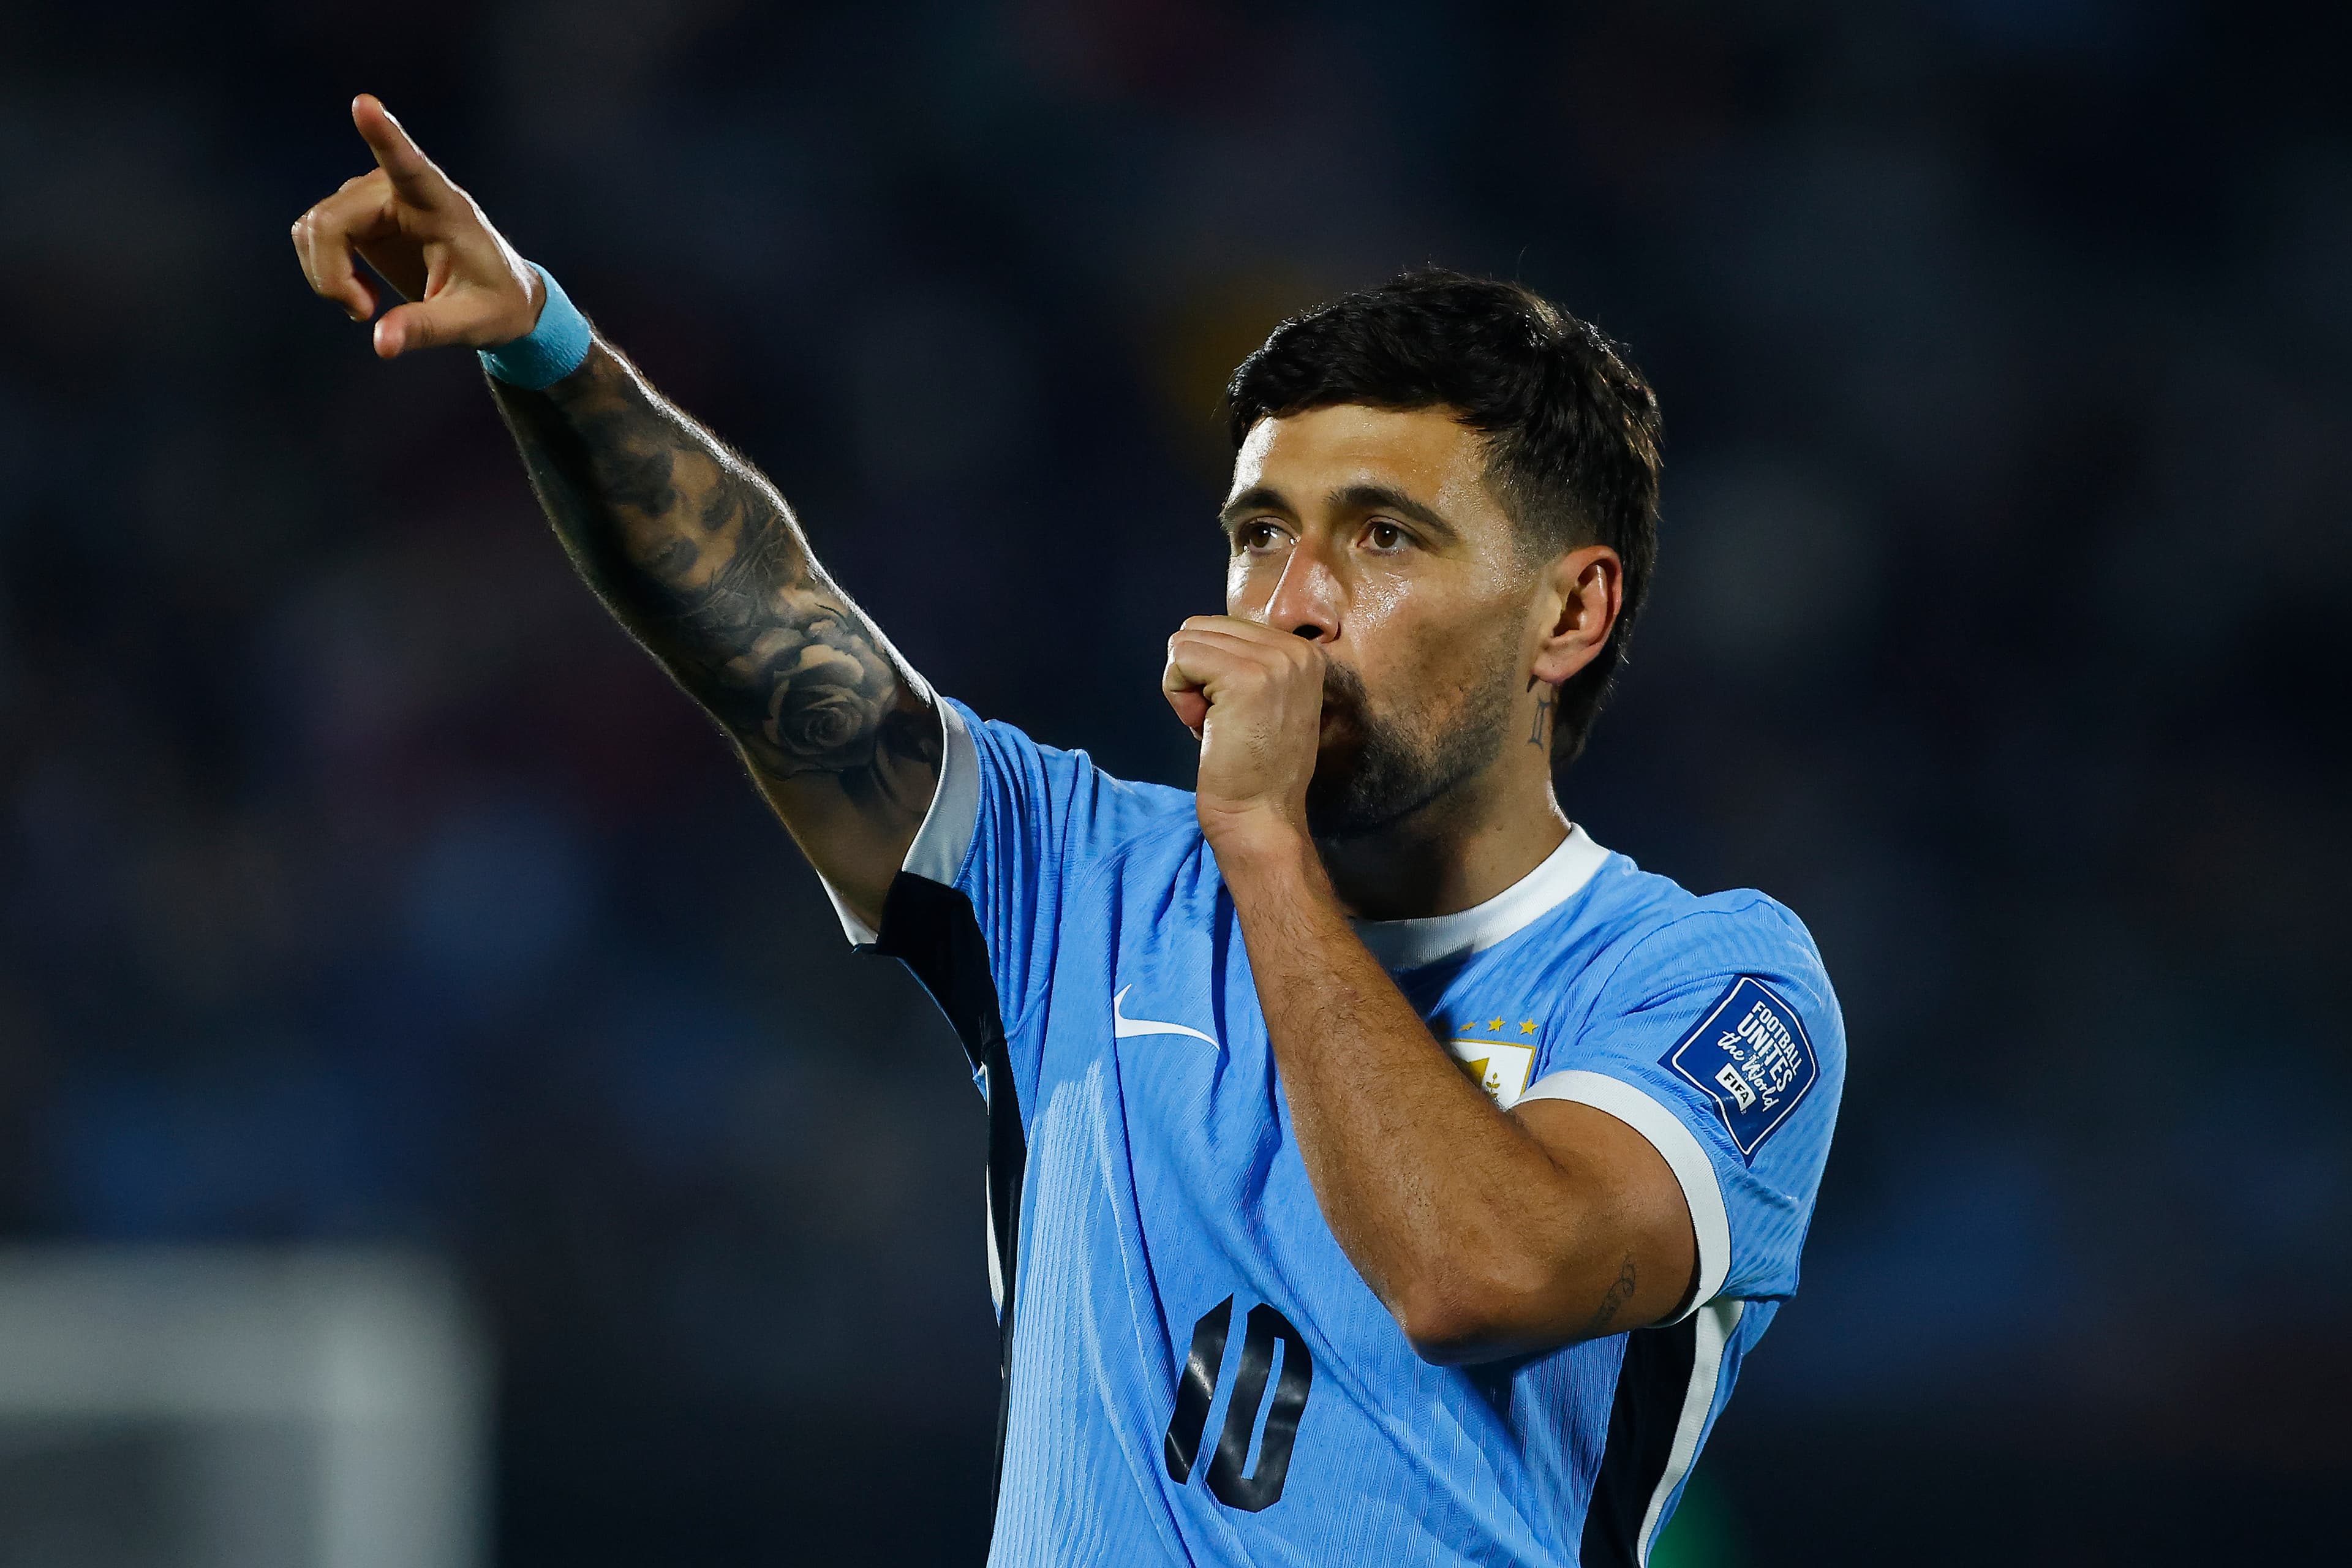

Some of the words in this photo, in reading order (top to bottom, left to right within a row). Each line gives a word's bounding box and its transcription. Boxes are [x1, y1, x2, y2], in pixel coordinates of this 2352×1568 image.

[1717, 1031, 1745, 1061] the
[1741, 1054, 1779, 1112] World
[1737, 1013, 1793, 1093] UNITES
[1752, 1001, 1803, 1076] FOOTBALL
[1723, 1072, 1750, 1104] FIFA
[1164, 1292, 1313, 1513] 10
